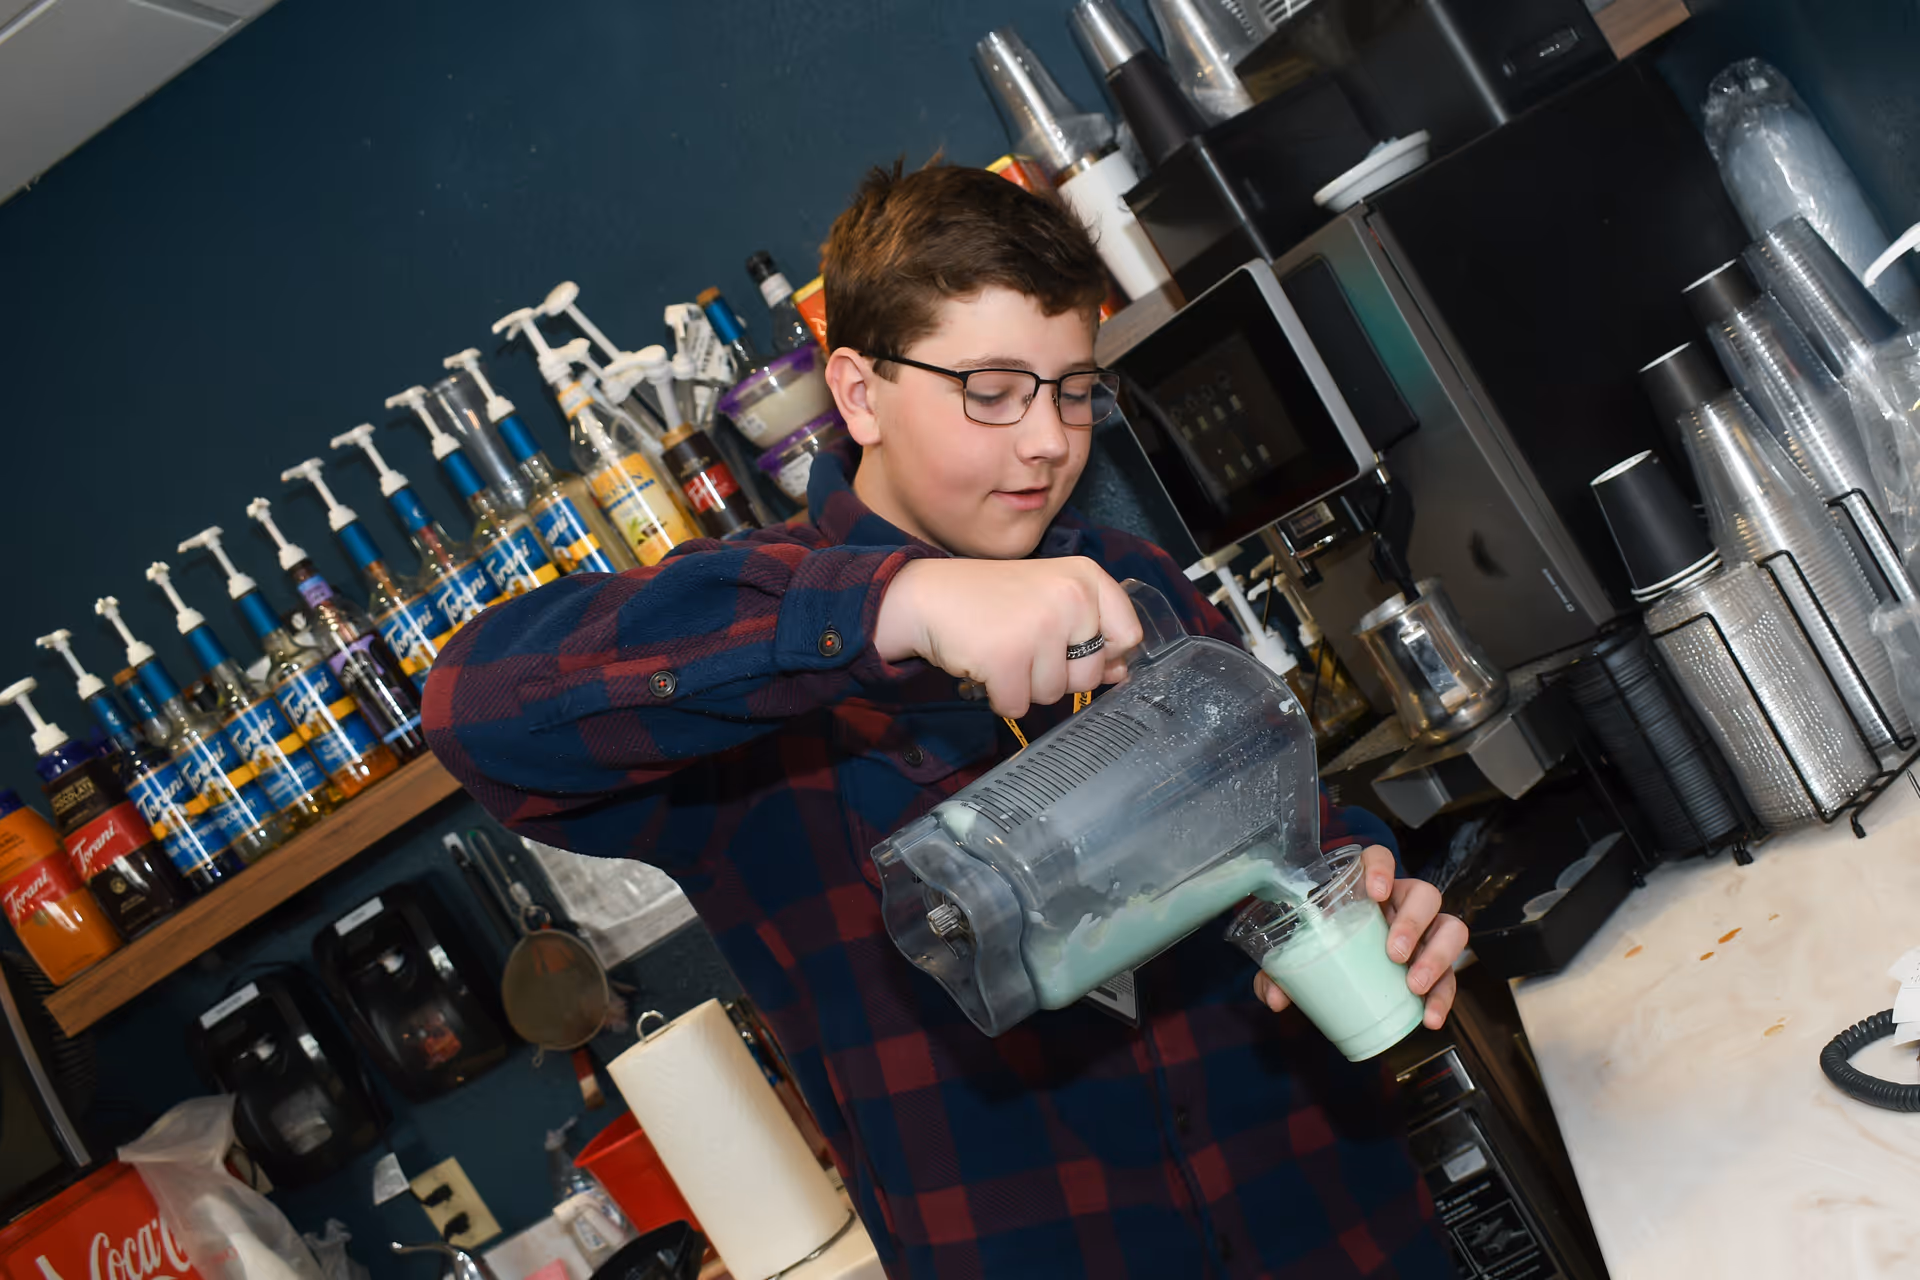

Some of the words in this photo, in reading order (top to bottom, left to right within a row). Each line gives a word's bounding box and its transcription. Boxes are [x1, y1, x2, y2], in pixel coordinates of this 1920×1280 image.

[485, 538, 530, 586] Torani
[436, 567, 488, 625] Torani
[384, 603, 434, 660] Torani
[281, 671, 331, 725] Torani
[231, 708, 277, 757] Torani
[181, 740, 227, 791] Torani
[136, 770, 186, 825] Torani
[70, 819, 118, 871] Torani
[3, 867, 51, 918] Torani
